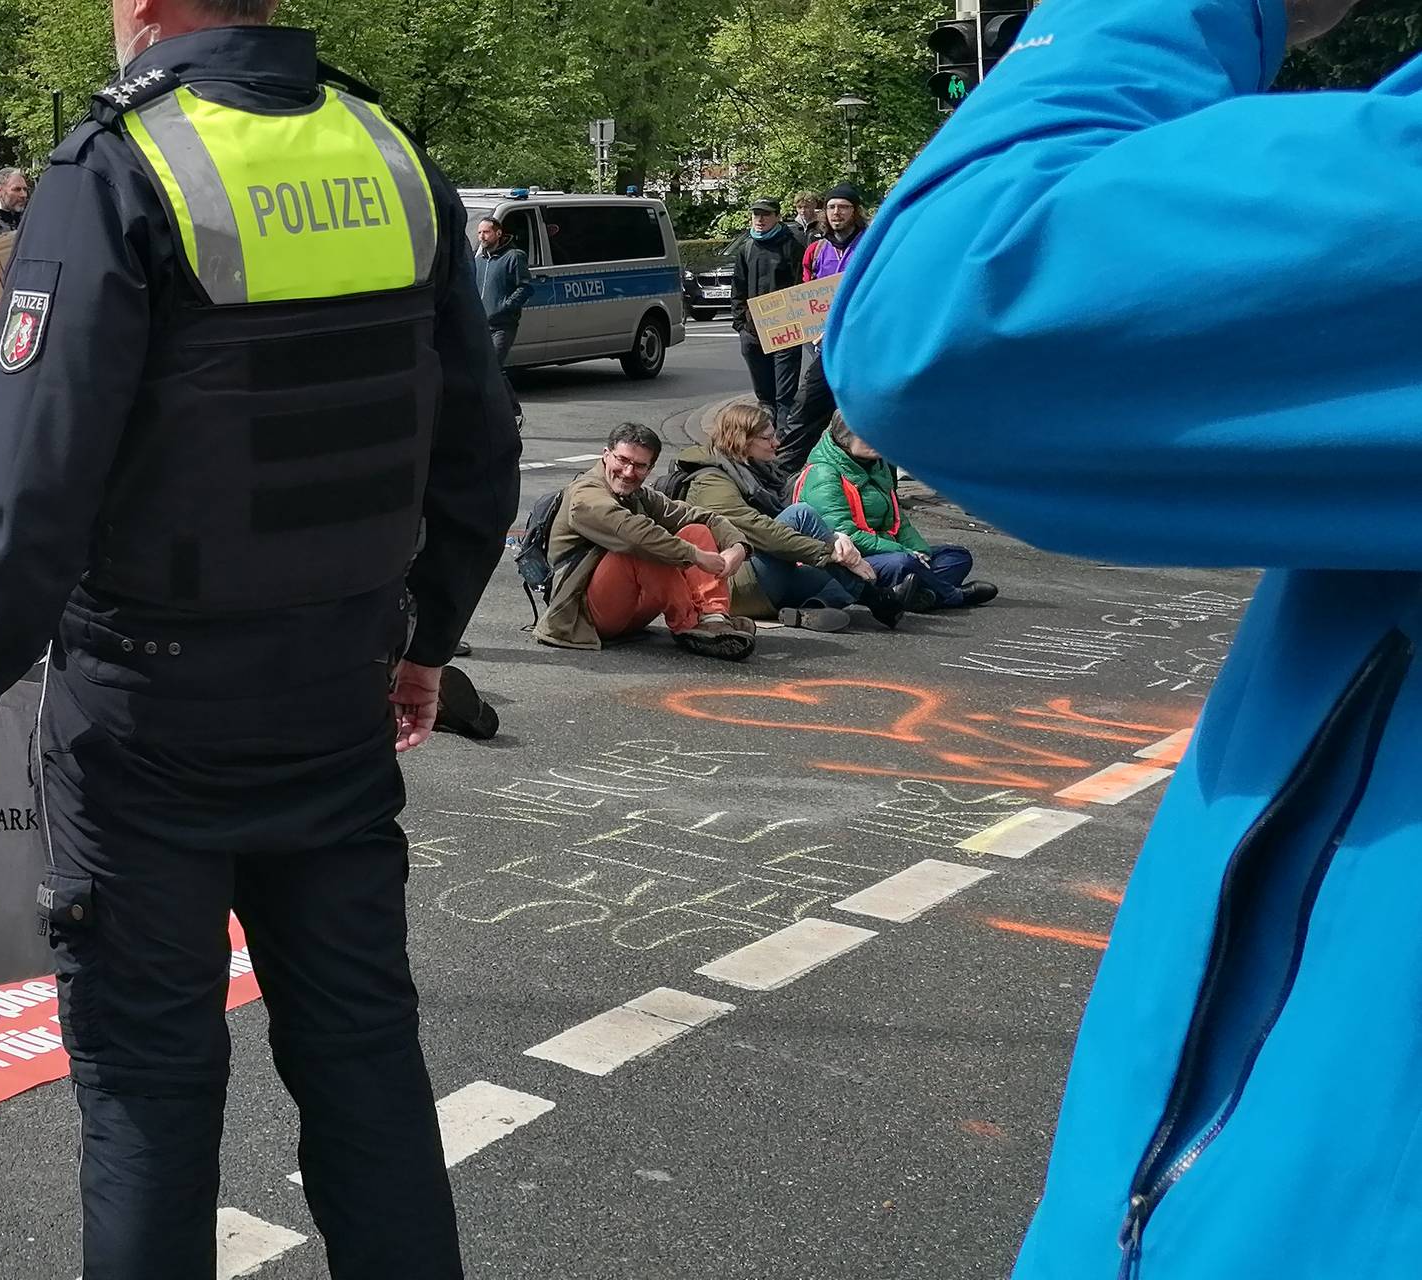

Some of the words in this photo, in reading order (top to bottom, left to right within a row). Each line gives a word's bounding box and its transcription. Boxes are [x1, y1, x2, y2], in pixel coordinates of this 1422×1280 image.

[247, 176, 391, 237] POLIZEI
[564, 279, 605, 299] POLIZEI
[13, 295, 47, 311] POLIZEI
[809, 298, 831, 315] Rei
[771, 324, 802, 346] nicht
